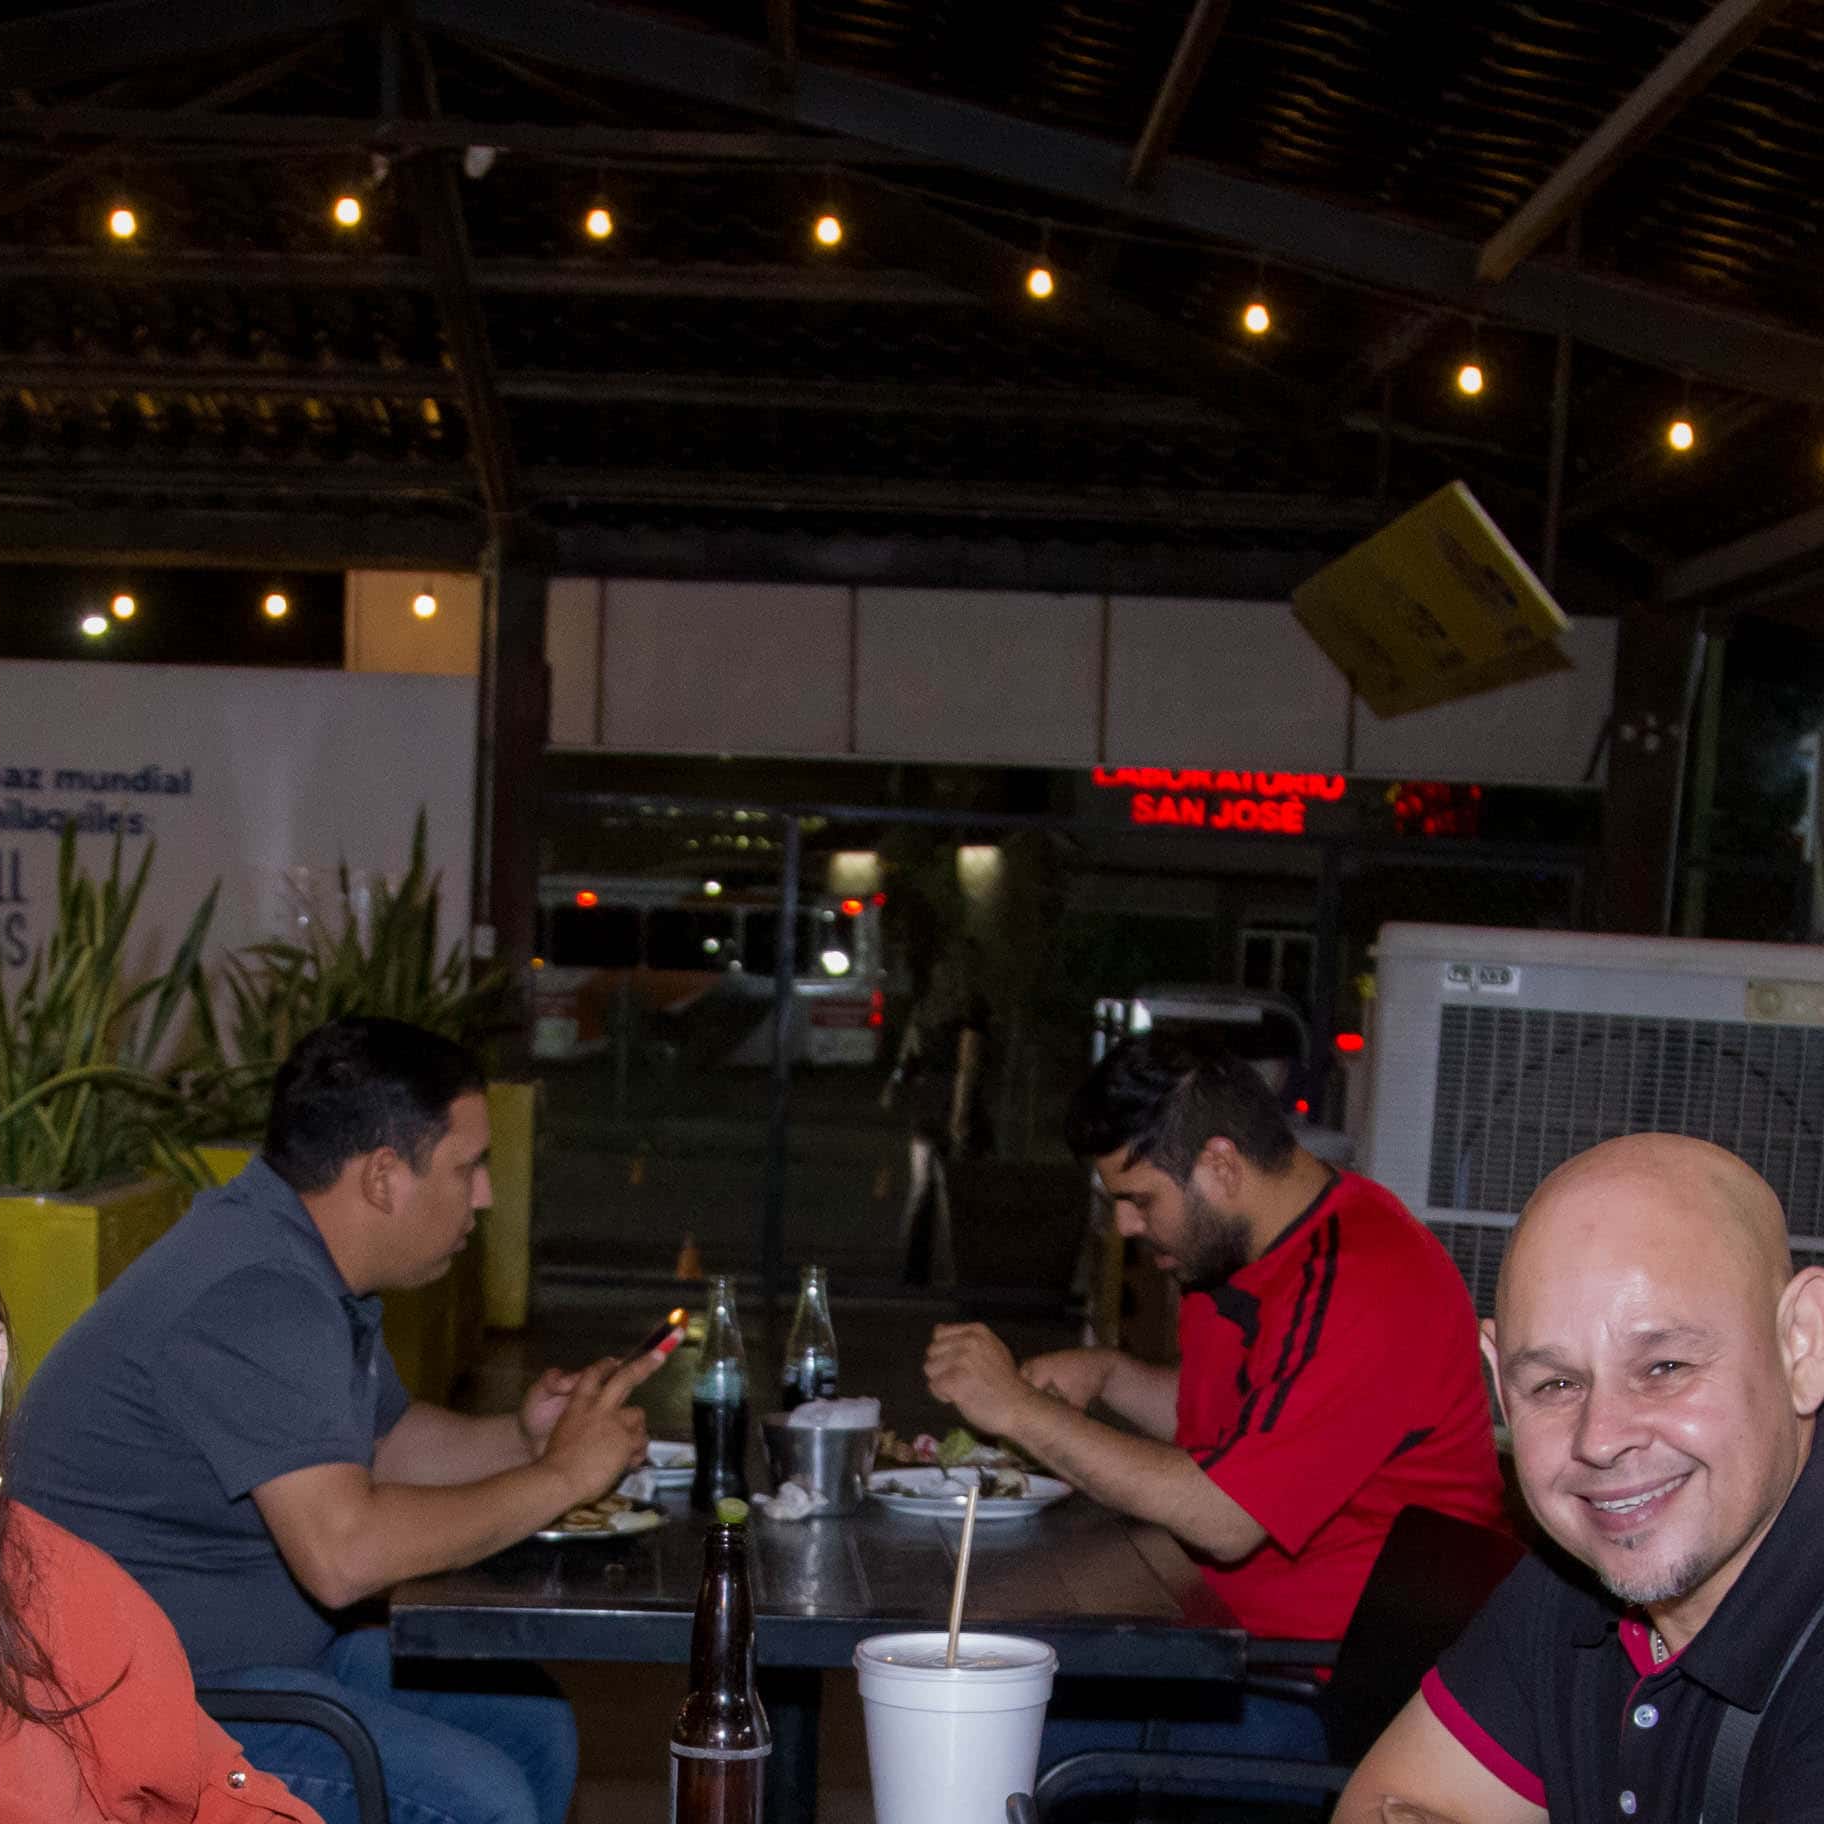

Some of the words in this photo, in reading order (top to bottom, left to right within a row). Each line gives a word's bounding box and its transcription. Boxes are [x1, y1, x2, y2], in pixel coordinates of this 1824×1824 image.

[54, 764, 193, 794] mundial
[1132, 794, 1206, 826] SAN
[1210, 796, 1307, 835] JOSÉ
